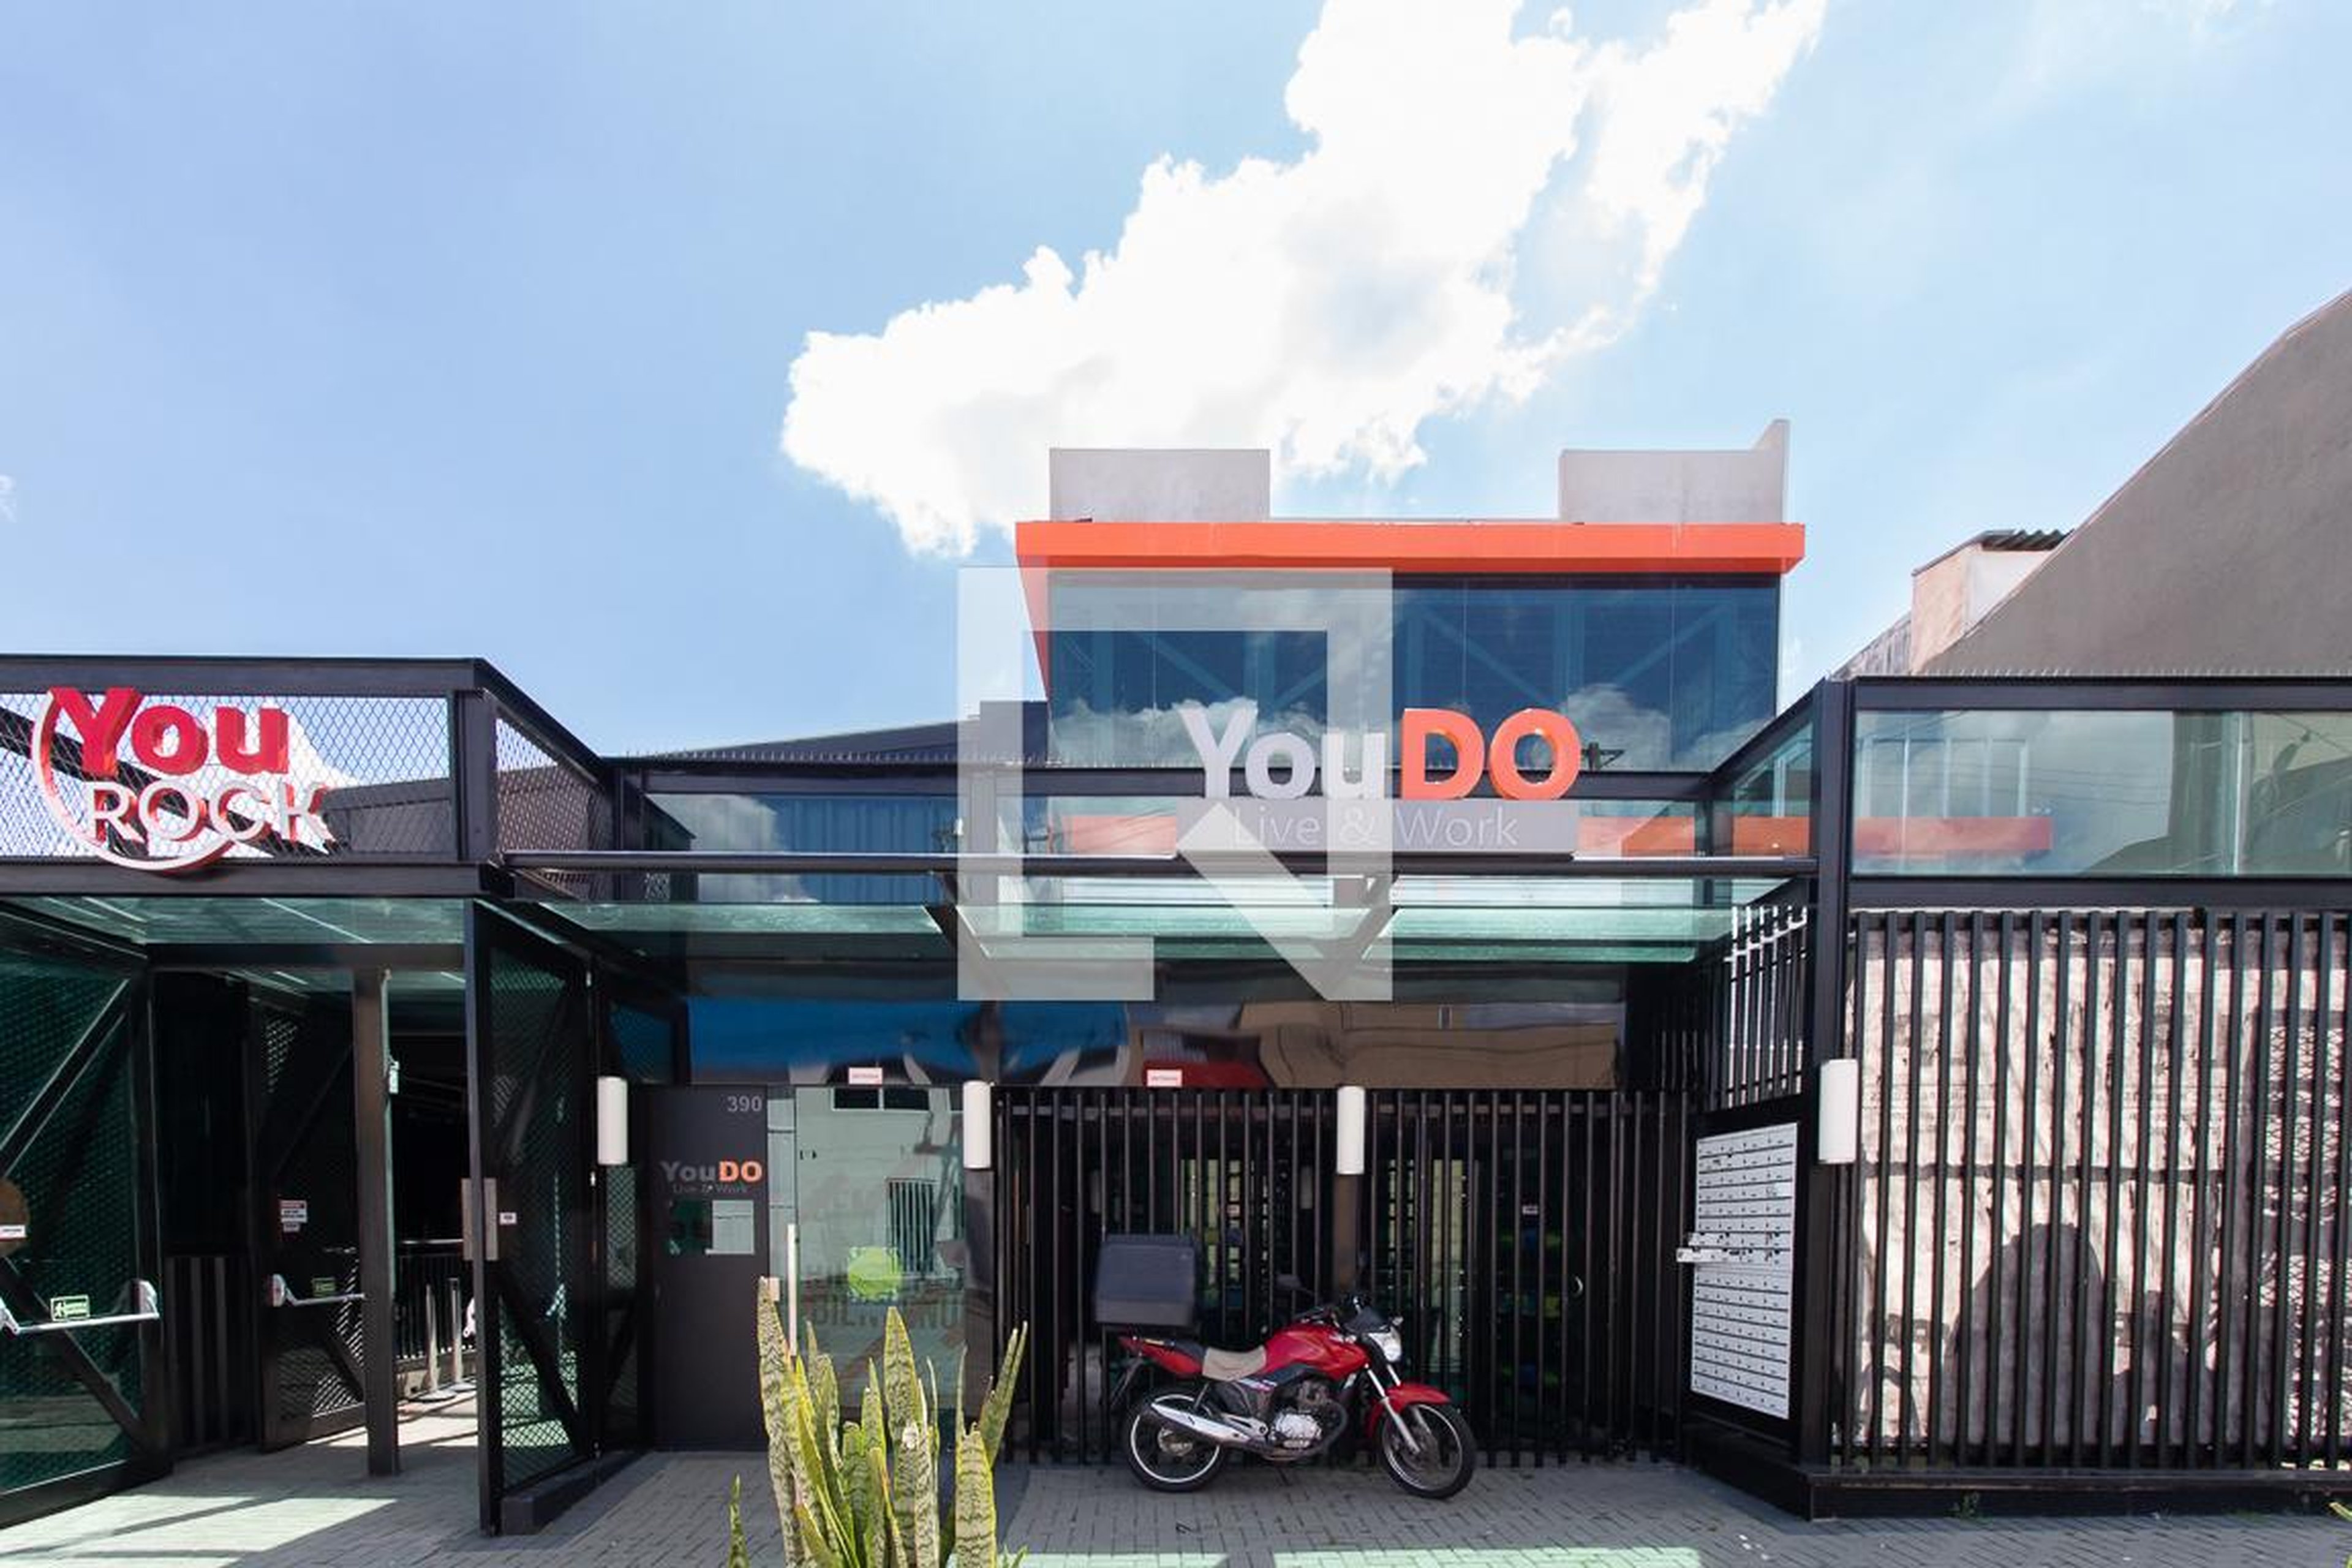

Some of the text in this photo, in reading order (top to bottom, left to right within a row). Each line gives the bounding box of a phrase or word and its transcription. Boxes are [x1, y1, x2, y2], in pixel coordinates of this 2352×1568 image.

[50, 687, 290, 777] You
[1178, 706, 1581, 801] YouDO
[85, 781, 333, 843] ROCK
[1232, 803, 1518, 846] Live & Work
[726, 1096, 763, 1113] 390
[660, 1160, 763, 1182] YouDO
